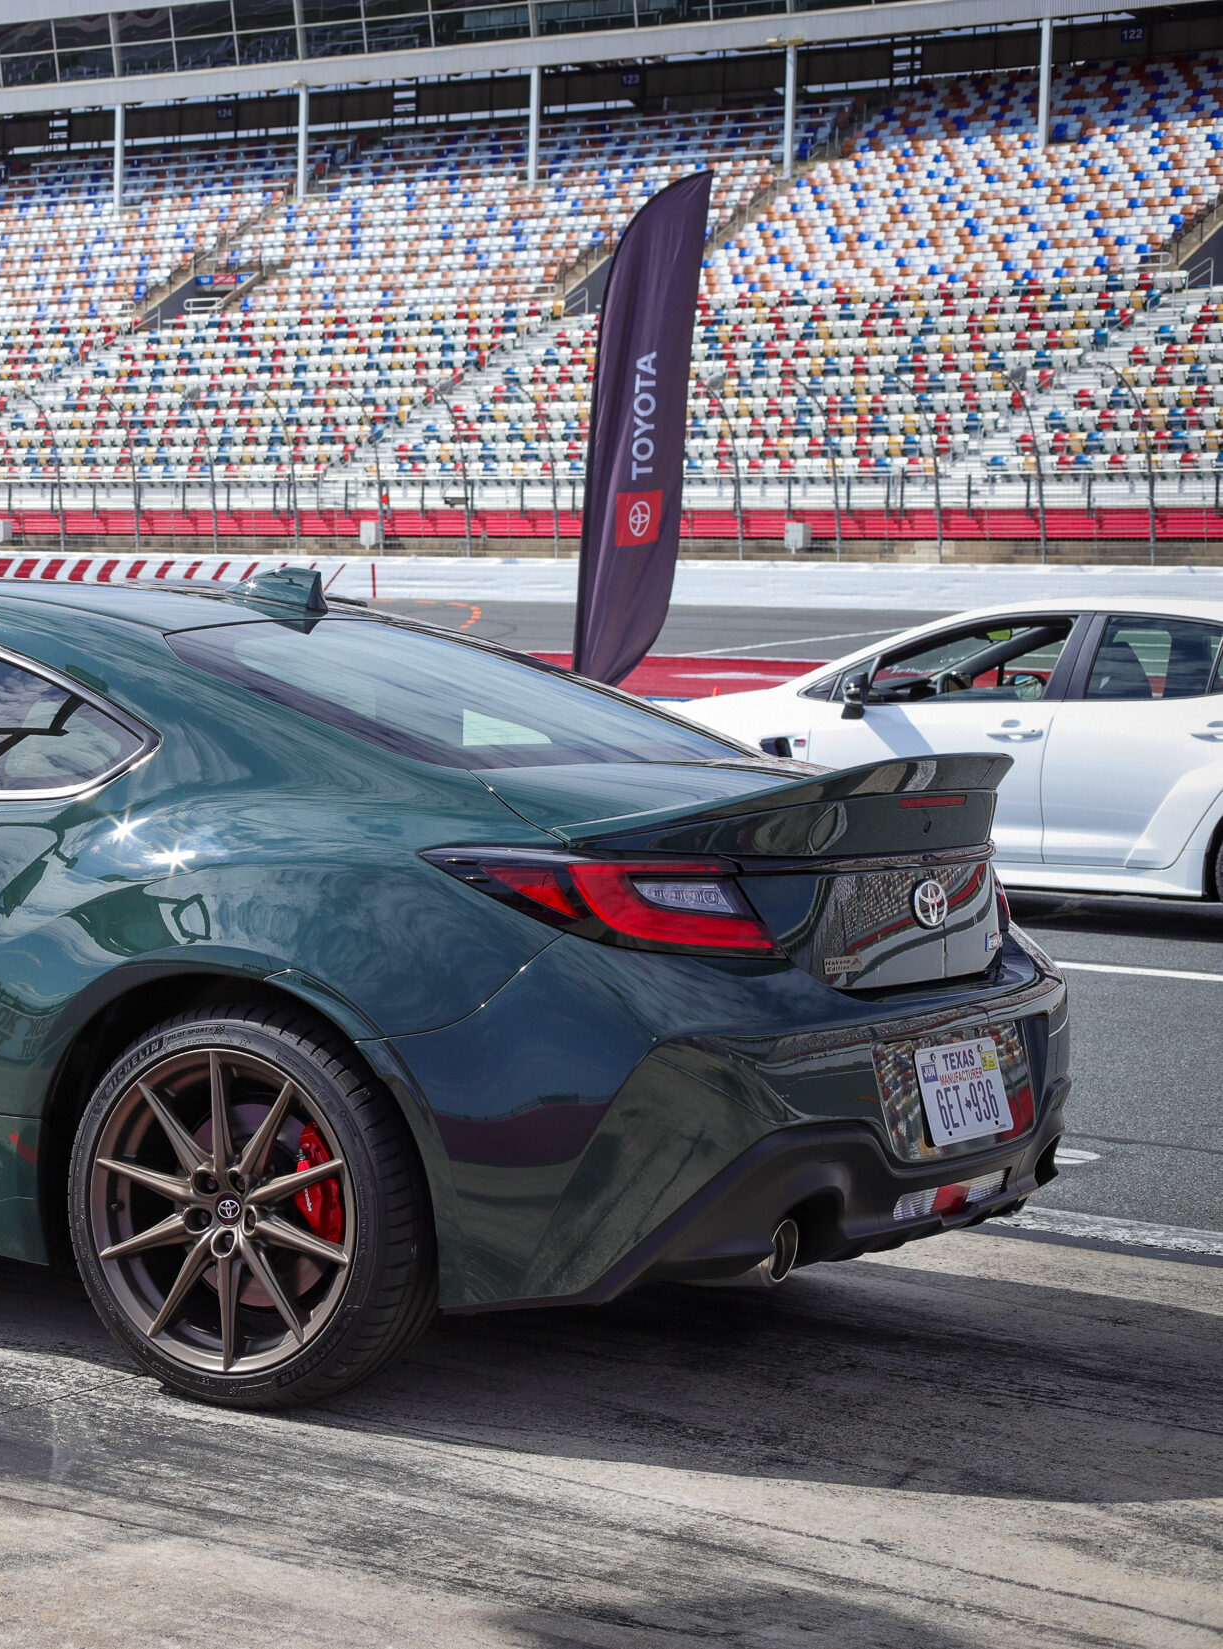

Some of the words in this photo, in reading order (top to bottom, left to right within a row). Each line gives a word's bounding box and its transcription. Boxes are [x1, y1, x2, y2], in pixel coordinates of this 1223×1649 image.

[1122, 28, 1143, 40] 122
[631, 351, 658, 481] TOYOTA
[168, 1031, 185, 1041] PILOT
[187, 1027, 208, 1035] SPORT
[105, 1040, 160, 1096] MICHELIN
[942, 1049, 975, 1071] TEXAS
[924, 1065, 936, 1079] JUN
[939, 1067, 984, 1086] MANUFACTURER
